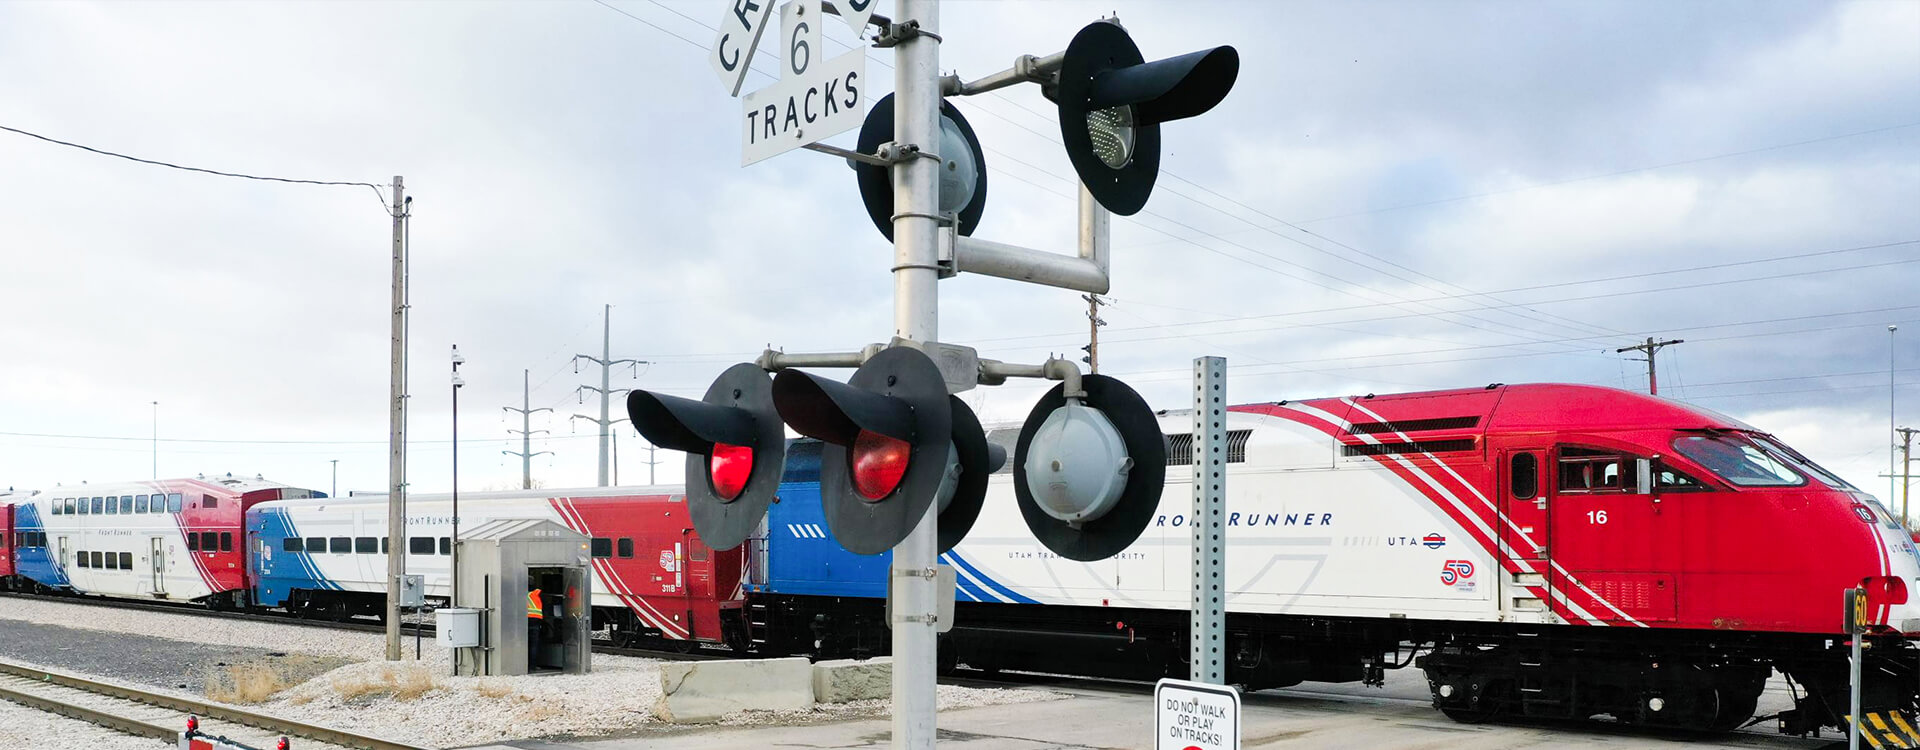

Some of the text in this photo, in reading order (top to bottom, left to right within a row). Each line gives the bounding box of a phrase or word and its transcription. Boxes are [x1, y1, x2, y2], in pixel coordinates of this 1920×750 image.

[791, 22, 810, 75] 6
[747, 71, 858, 144] TRACKS
[1586, 510, 1607, 524] 16
[1855, 507, 1872, 520] 16
[1388, 537, 1417, 546] UTA
[1441, 560, 1475, 586] 50
[1855, 595, 1867, 626] 60
[1825, 640, 1833, 649] F
[1167, 699, 1226, 719] DO NOT WALK
[1178, 714, 1214, 730] OR PLAY
[1170, 726, 1223, 746] ON TRACKS!
